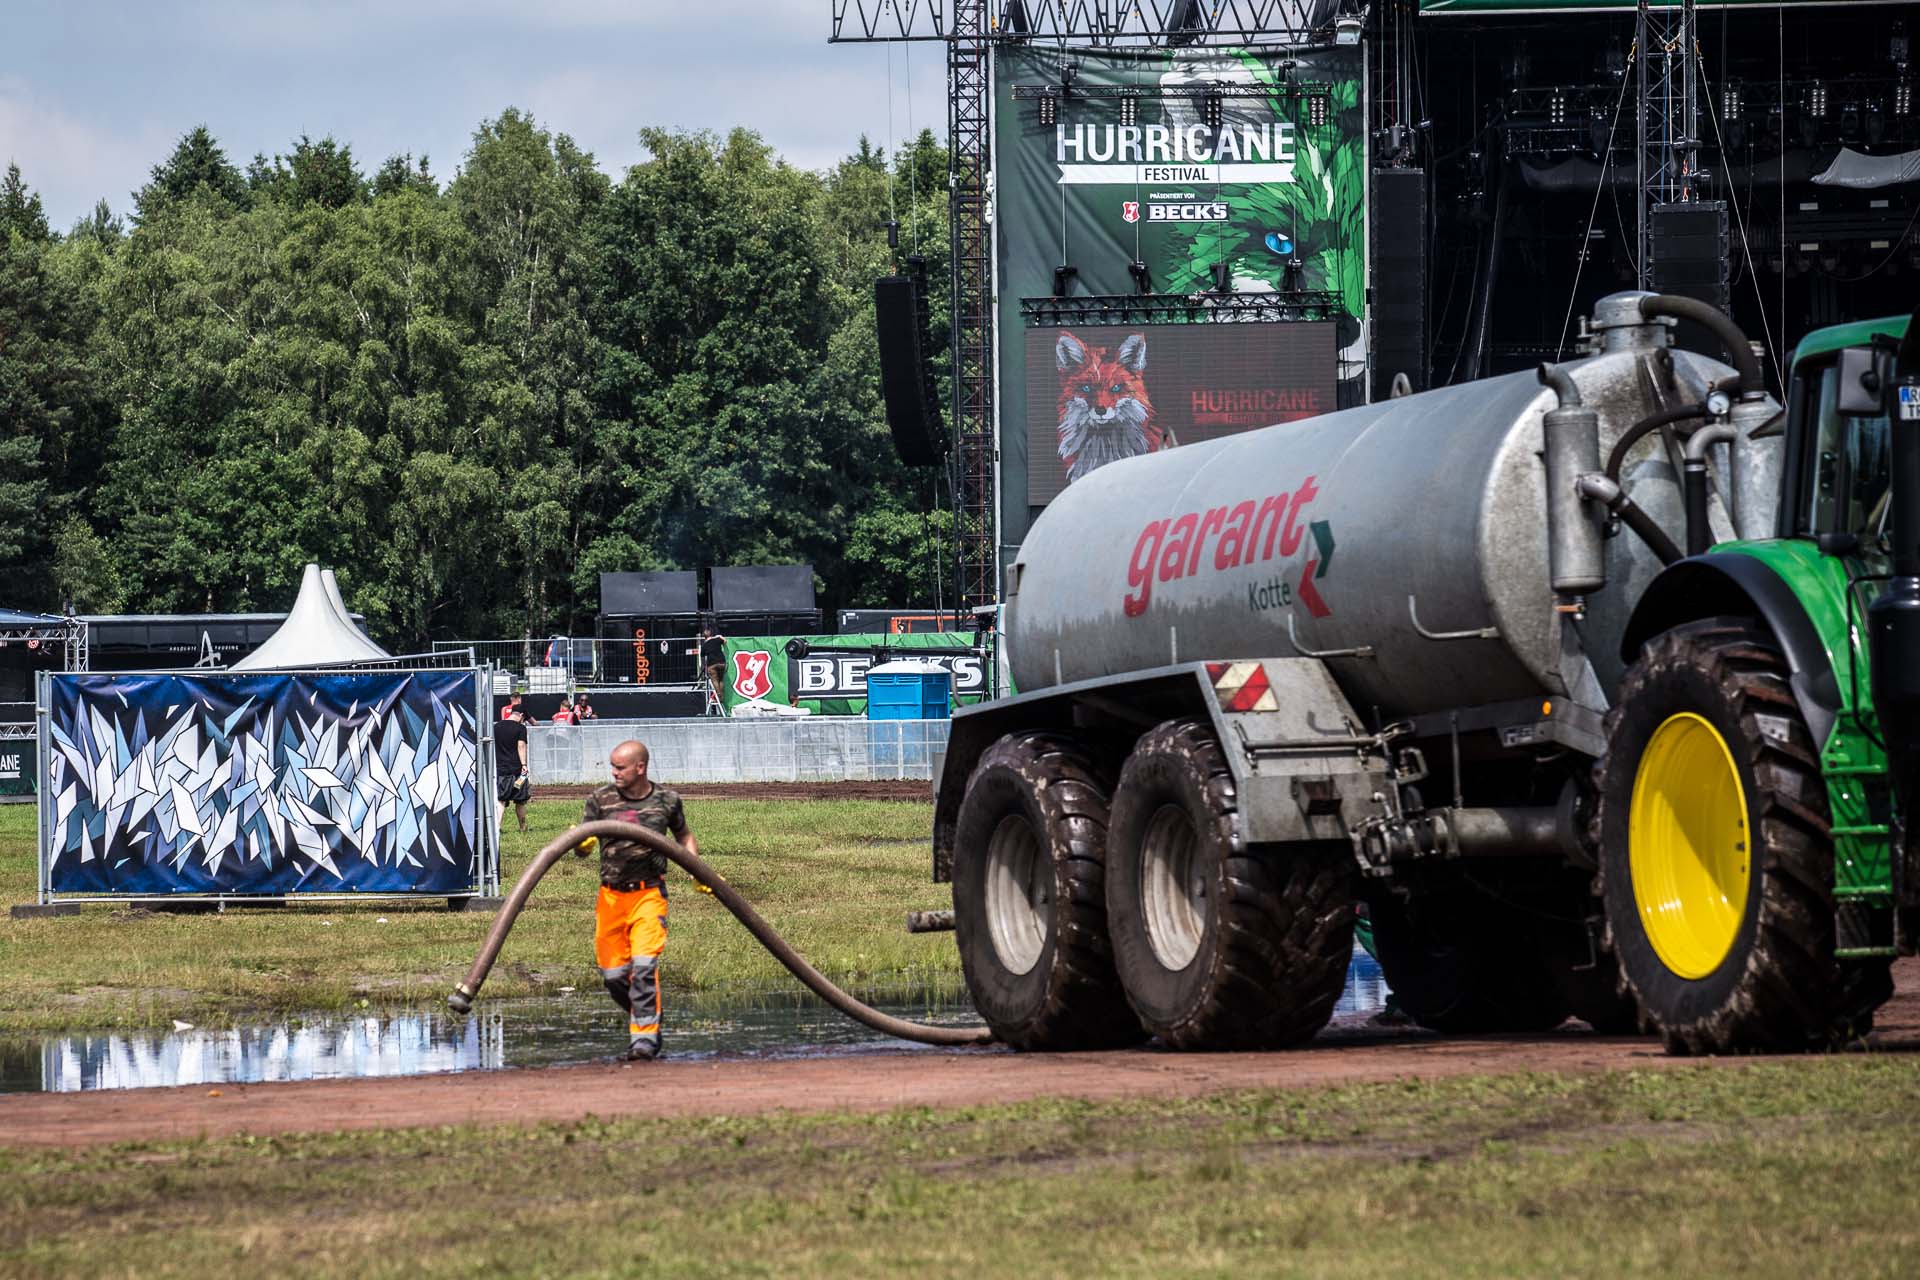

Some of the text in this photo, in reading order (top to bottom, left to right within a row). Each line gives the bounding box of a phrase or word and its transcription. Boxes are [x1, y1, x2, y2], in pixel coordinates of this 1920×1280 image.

[1057, 123, 1295, 161] HURRICANE
[1144, 167, 1210, 181] FESTIVAL
[1183, 192, 1196, 200] VON
[1149, 203, 1228, 220] BECK'S
[1191, 388, 1320, 412] HURRICANE
[1911, 388, 1920, 402] R
[1124, 475, 1319, 617] garant
[1248, 575, 1292, 611] Kotte
[632, 628, 650, 685] aggreko
